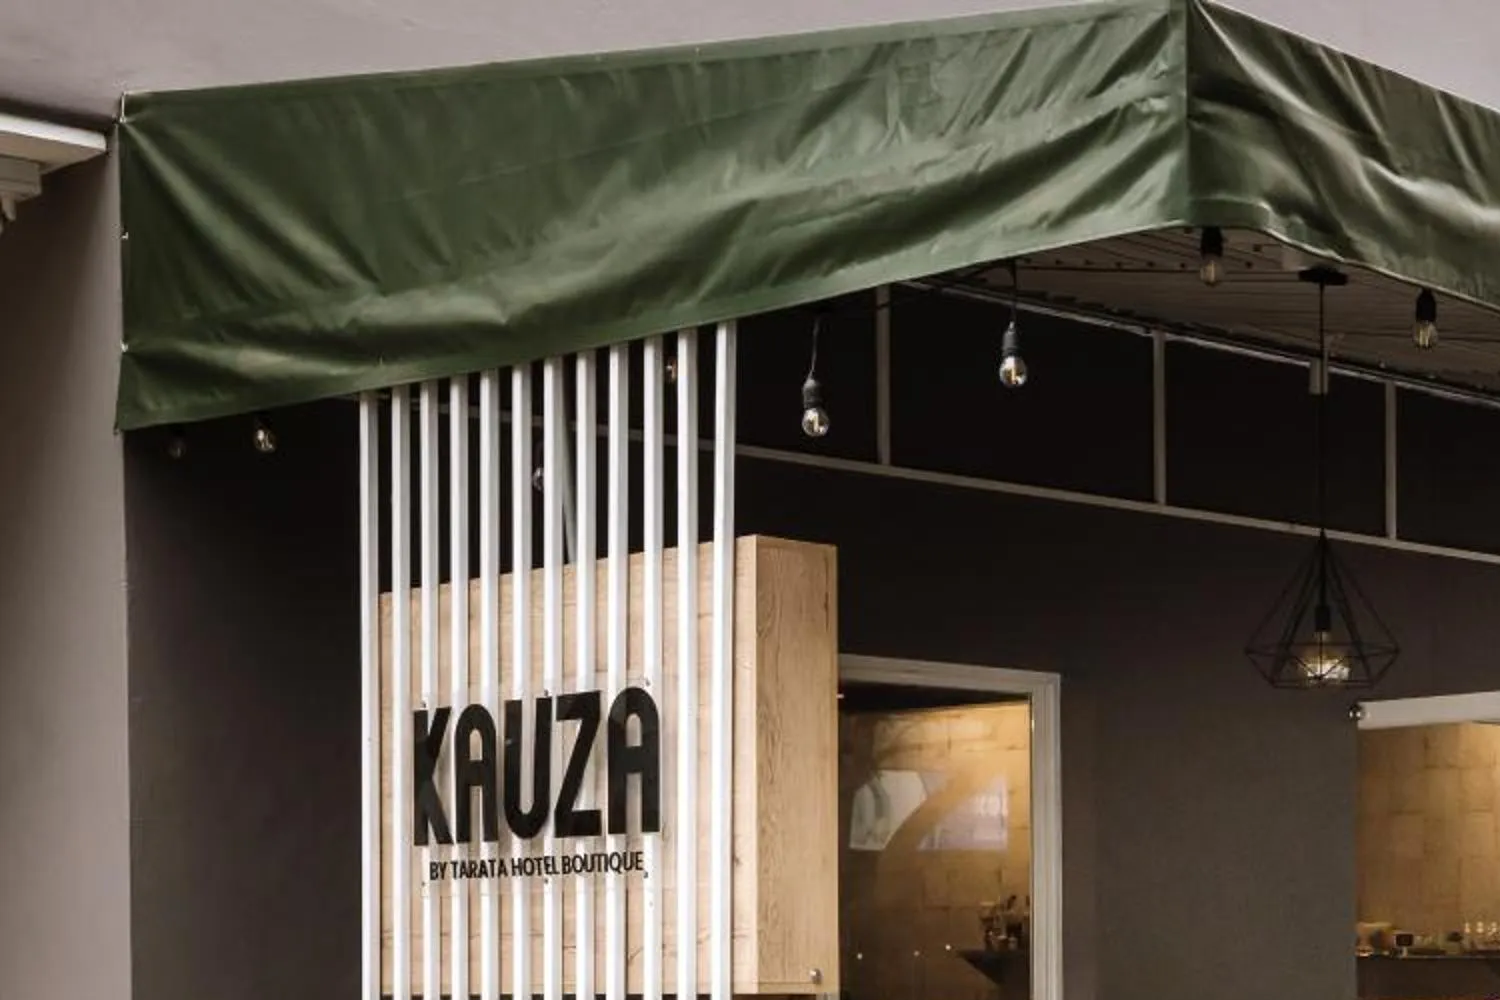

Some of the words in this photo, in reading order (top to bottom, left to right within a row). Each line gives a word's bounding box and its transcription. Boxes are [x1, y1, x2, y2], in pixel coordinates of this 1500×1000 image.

[413, 687, 661, 846] KAUZA
[429, 861, 449, 881] BY
[450, 858, 508, 880] TARATA
[511, 855, 560, 877] HOTEL
[562, 851, 644, 875] BOUTIQUE
